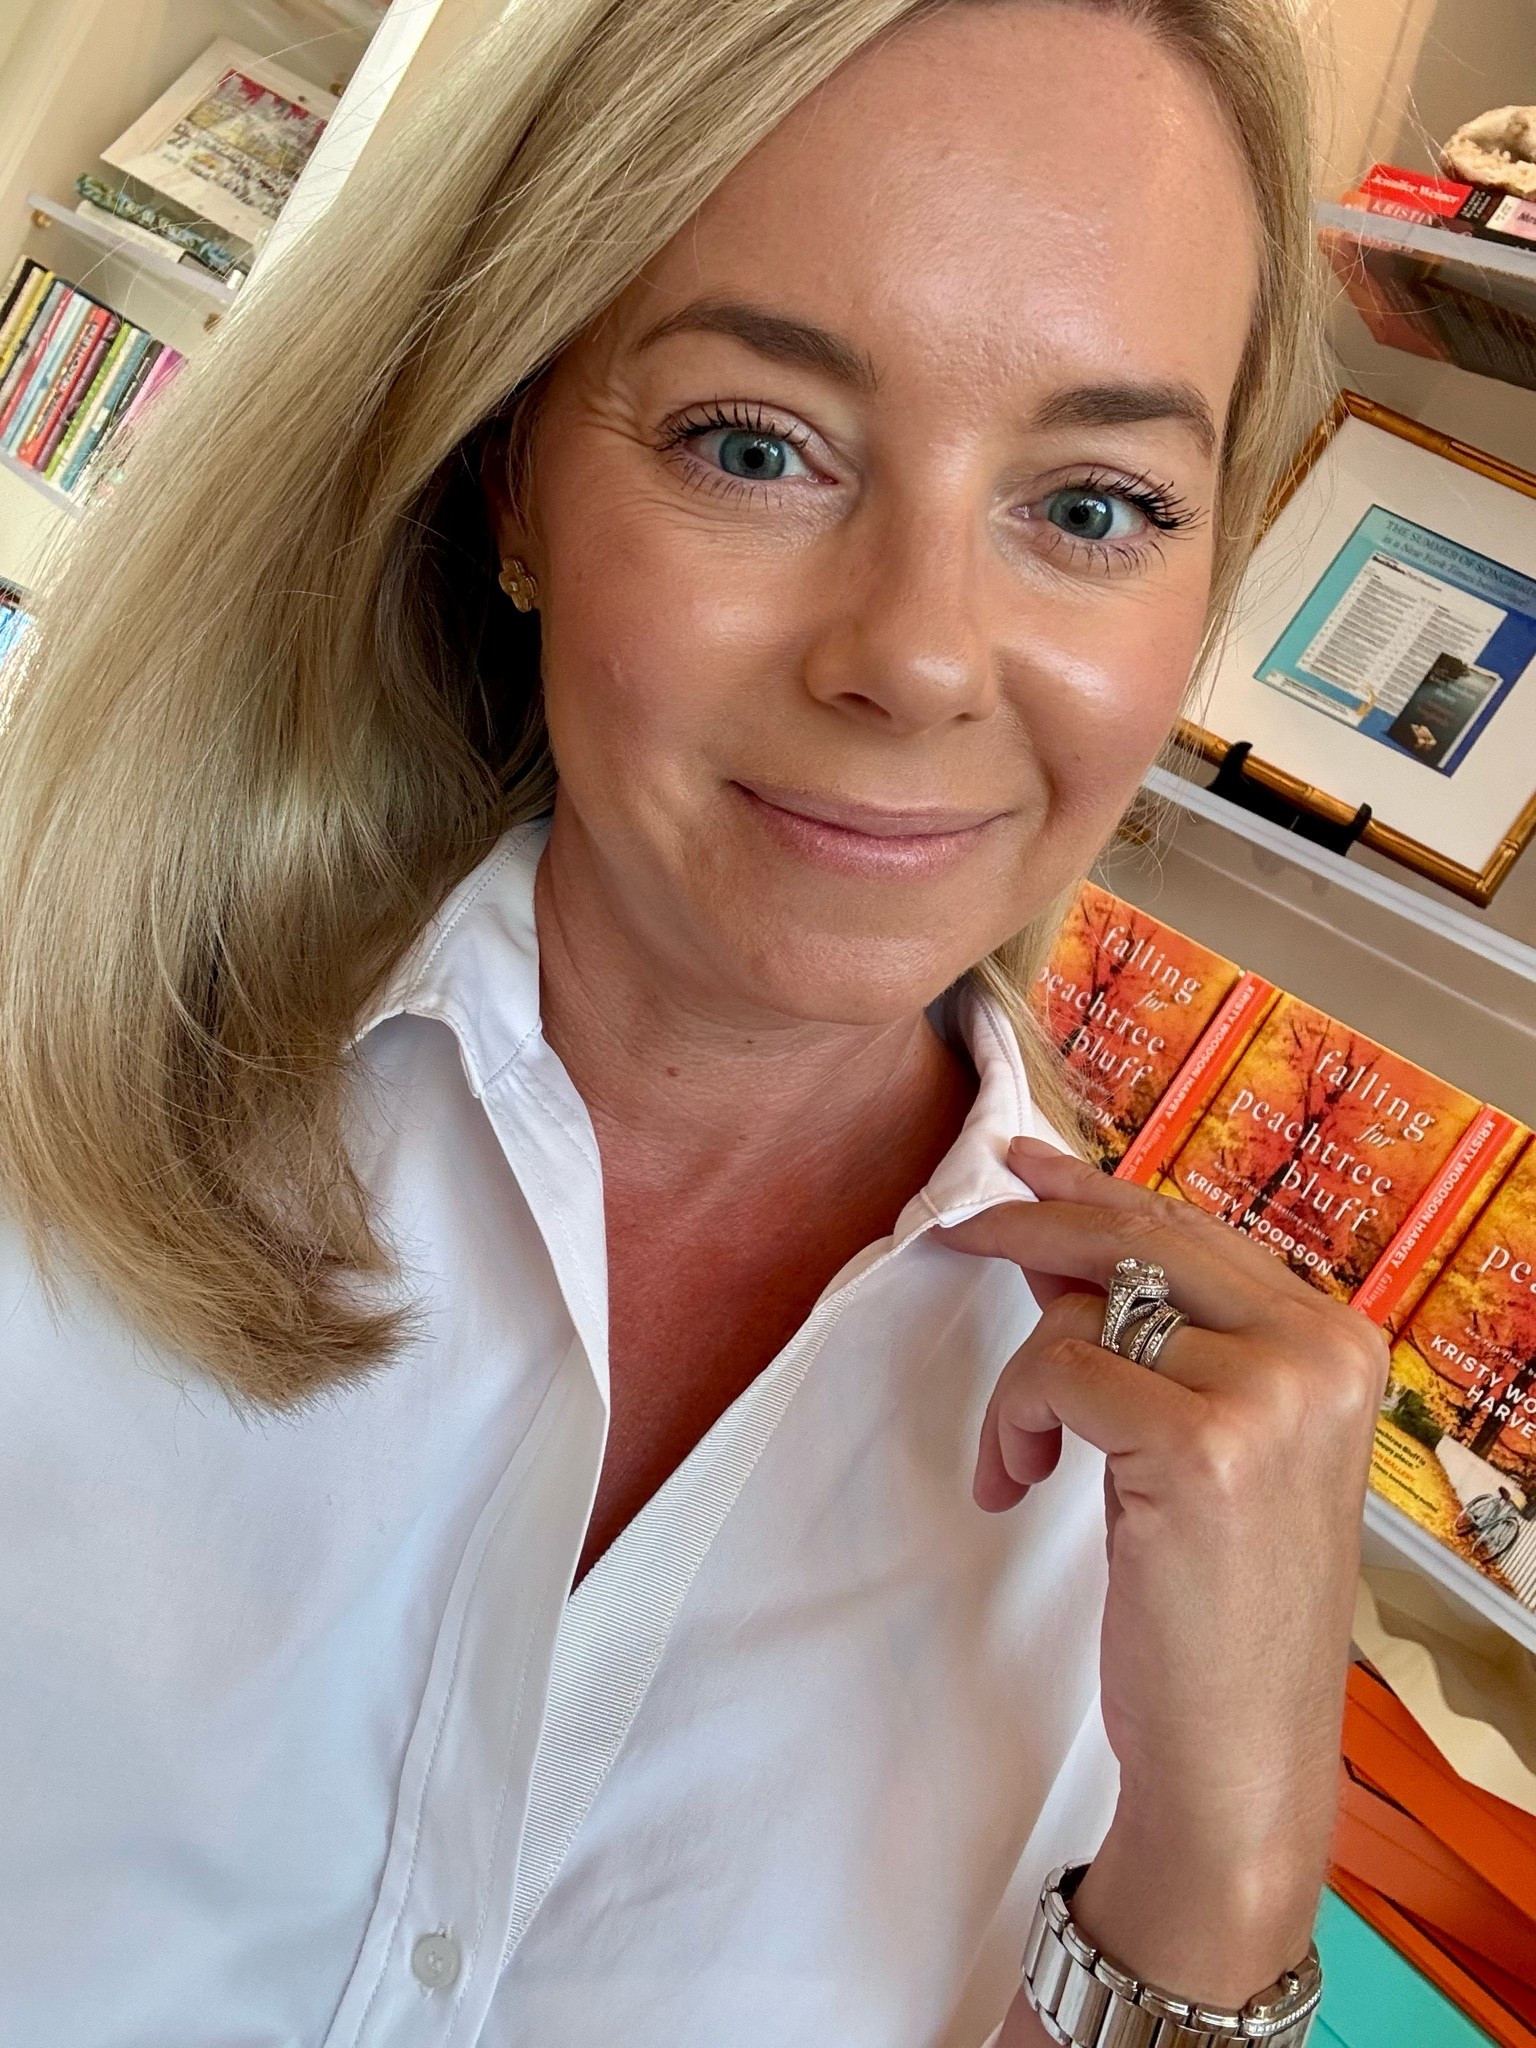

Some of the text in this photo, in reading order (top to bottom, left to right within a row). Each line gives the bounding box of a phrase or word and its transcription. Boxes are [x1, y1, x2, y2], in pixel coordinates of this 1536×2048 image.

[1102, 926, 1202, 1005] falling
[1133, 989, 1169, 1012] for
[1071, 1025, 1153, 1087] bluff
[1165, 984, 1255, 1120] KRISTY WOODSON HARVEY
[1315, 1050, 1435, 1142] falling
[1229, 1088, 1392, 1198] peachtree
[1354, 1122, 1396, 1149] for
[1187, 1170, 1243, 1213] KRISTY
[1242, 1208, 1334, 1276] WOODSON
[1281, 1160, 1379, 1232] bluff
[1390, 1119, 1496, 1270] KRISTY WOODSON HARVEY
[1431, 1334, 1504, 1388] KRISTY
[1402, 1445, 1421, 1461] Bluff
